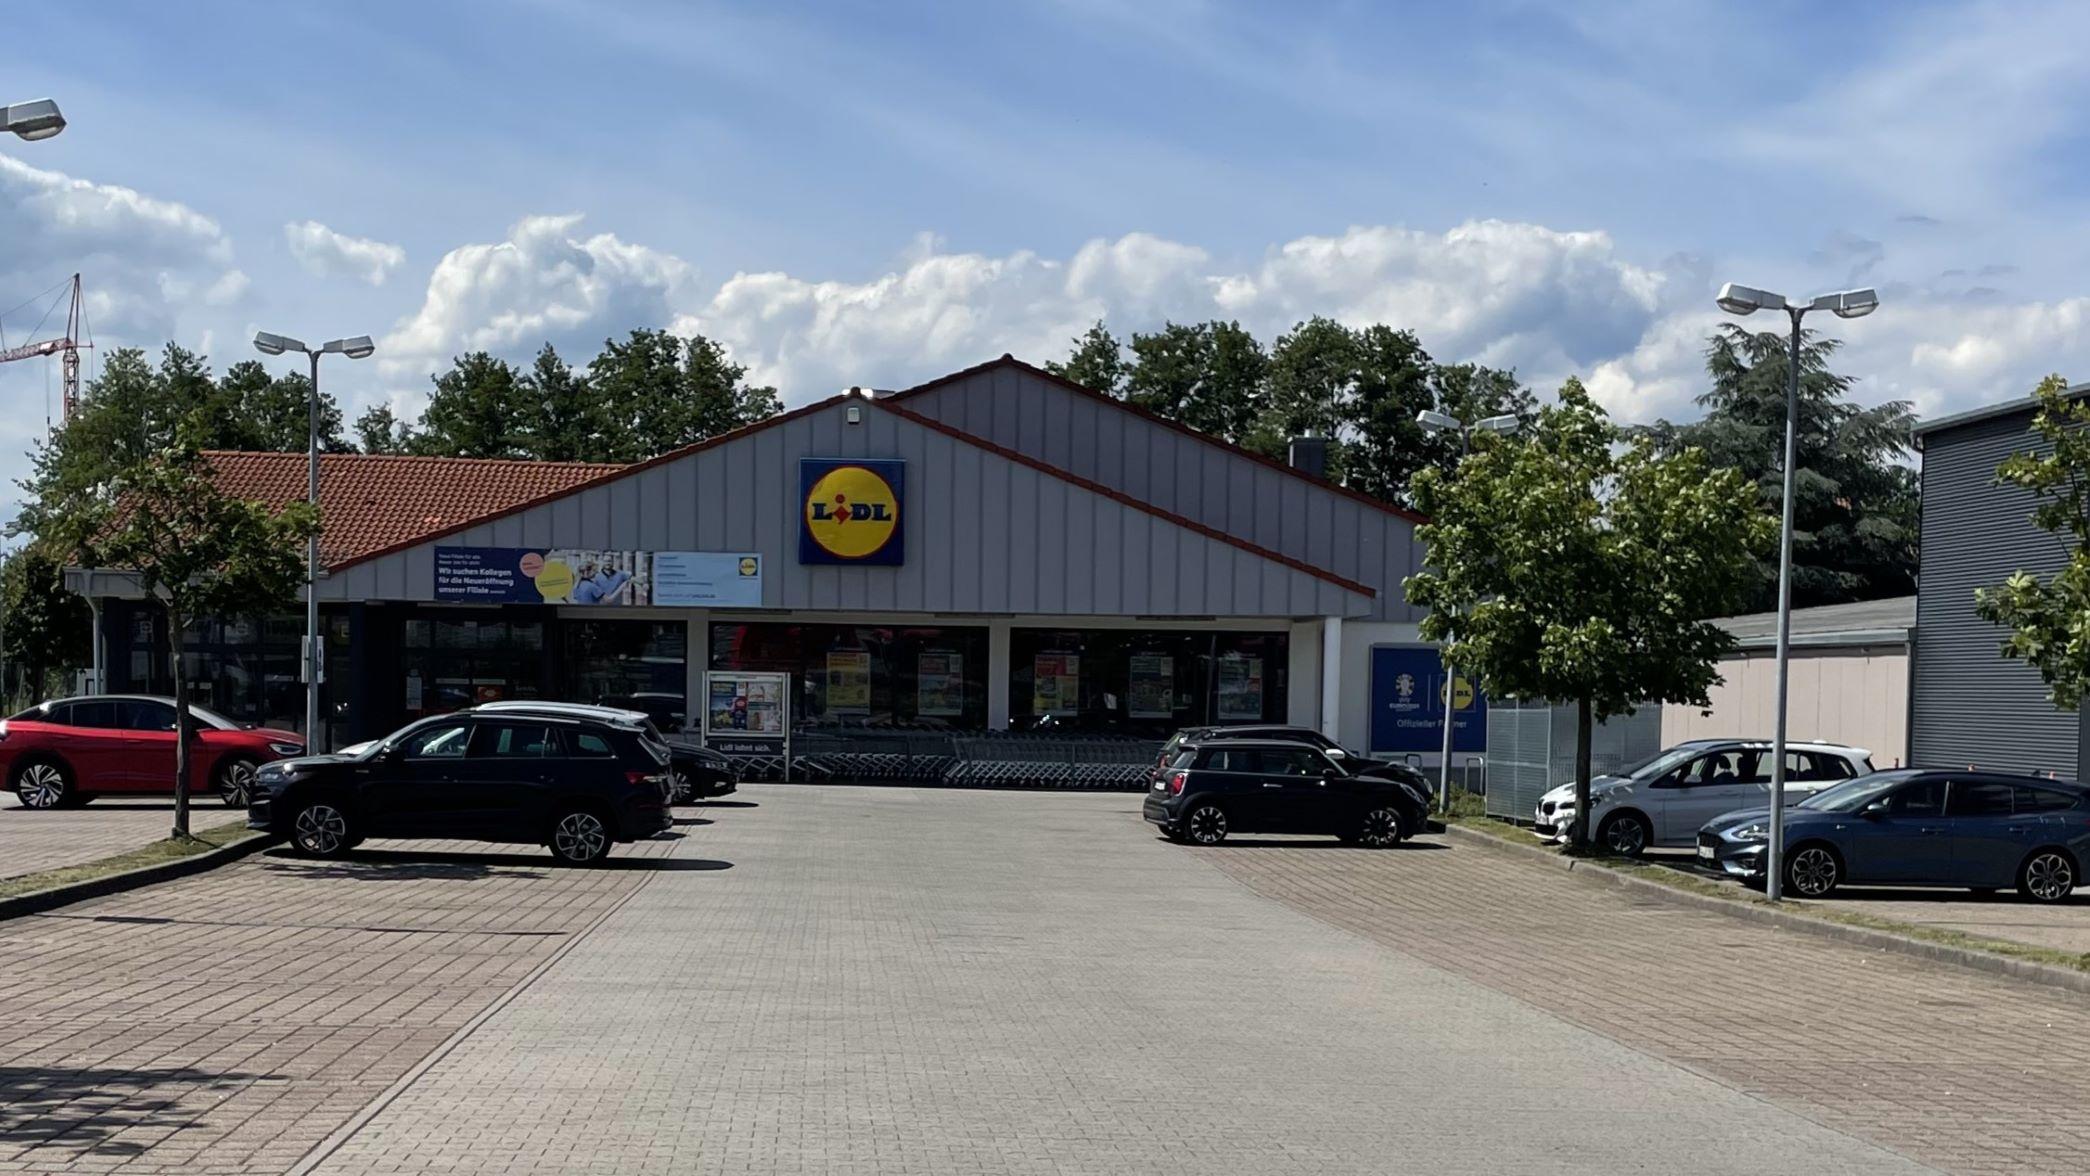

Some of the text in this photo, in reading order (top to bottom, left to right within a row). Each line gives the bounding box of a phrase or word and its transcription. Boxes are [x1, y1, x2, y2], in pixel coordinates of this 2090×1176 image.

[438, 567, 451, 575] Wir
[480, 568, 512, 577] Kollegen
[438, 576, 450, 584] für
[463, 577, 514, 587] Neueröffnung
[467, 586, 489, 594] Filiale
[1396, 719, 1467, 728] Offizieller Pner
